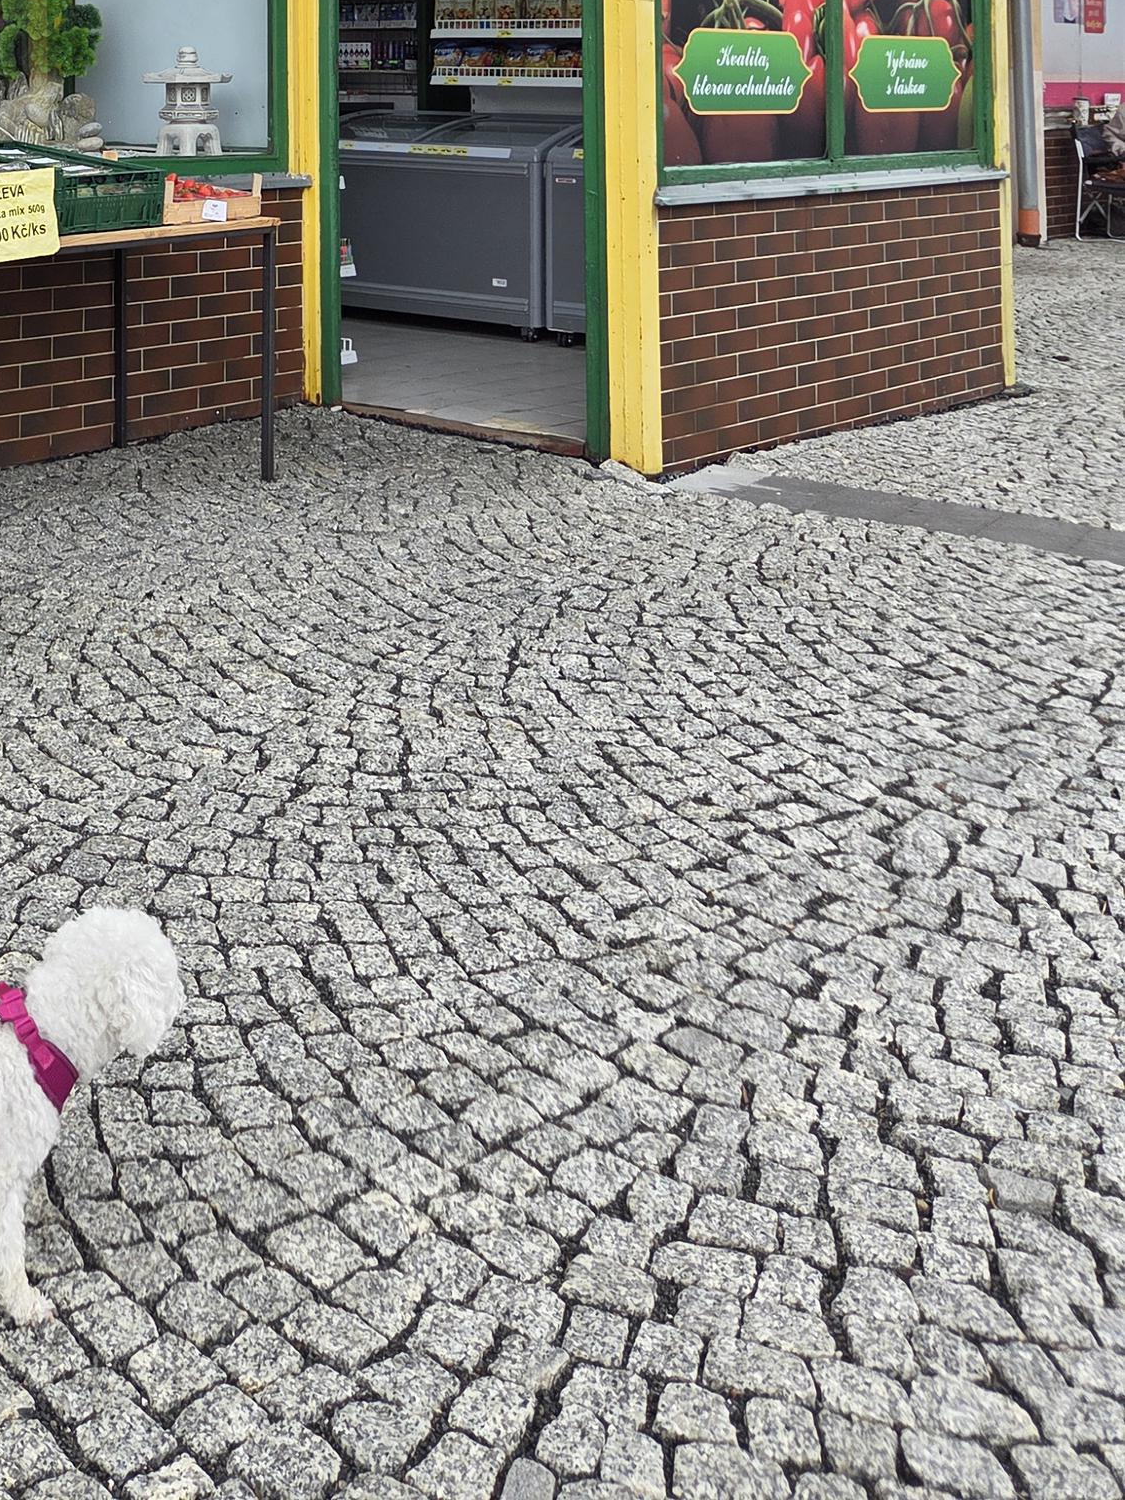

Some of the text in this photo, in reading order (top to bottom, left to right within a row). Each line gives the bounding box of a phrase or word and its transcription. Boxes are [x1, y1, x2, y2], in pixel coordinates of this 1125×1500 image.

[716, 44, 769, 72] Kvalita,
[885, 49, 929, 77] Vybráno
[692, 74, 796, 96] kterou ochutnáte
[885, 76, 927, 96] s láskou
[9, 206, 25, 217] mix
[28, 203, 46, 214] 500g
[11, 222, 47, 240] Kč/ks
